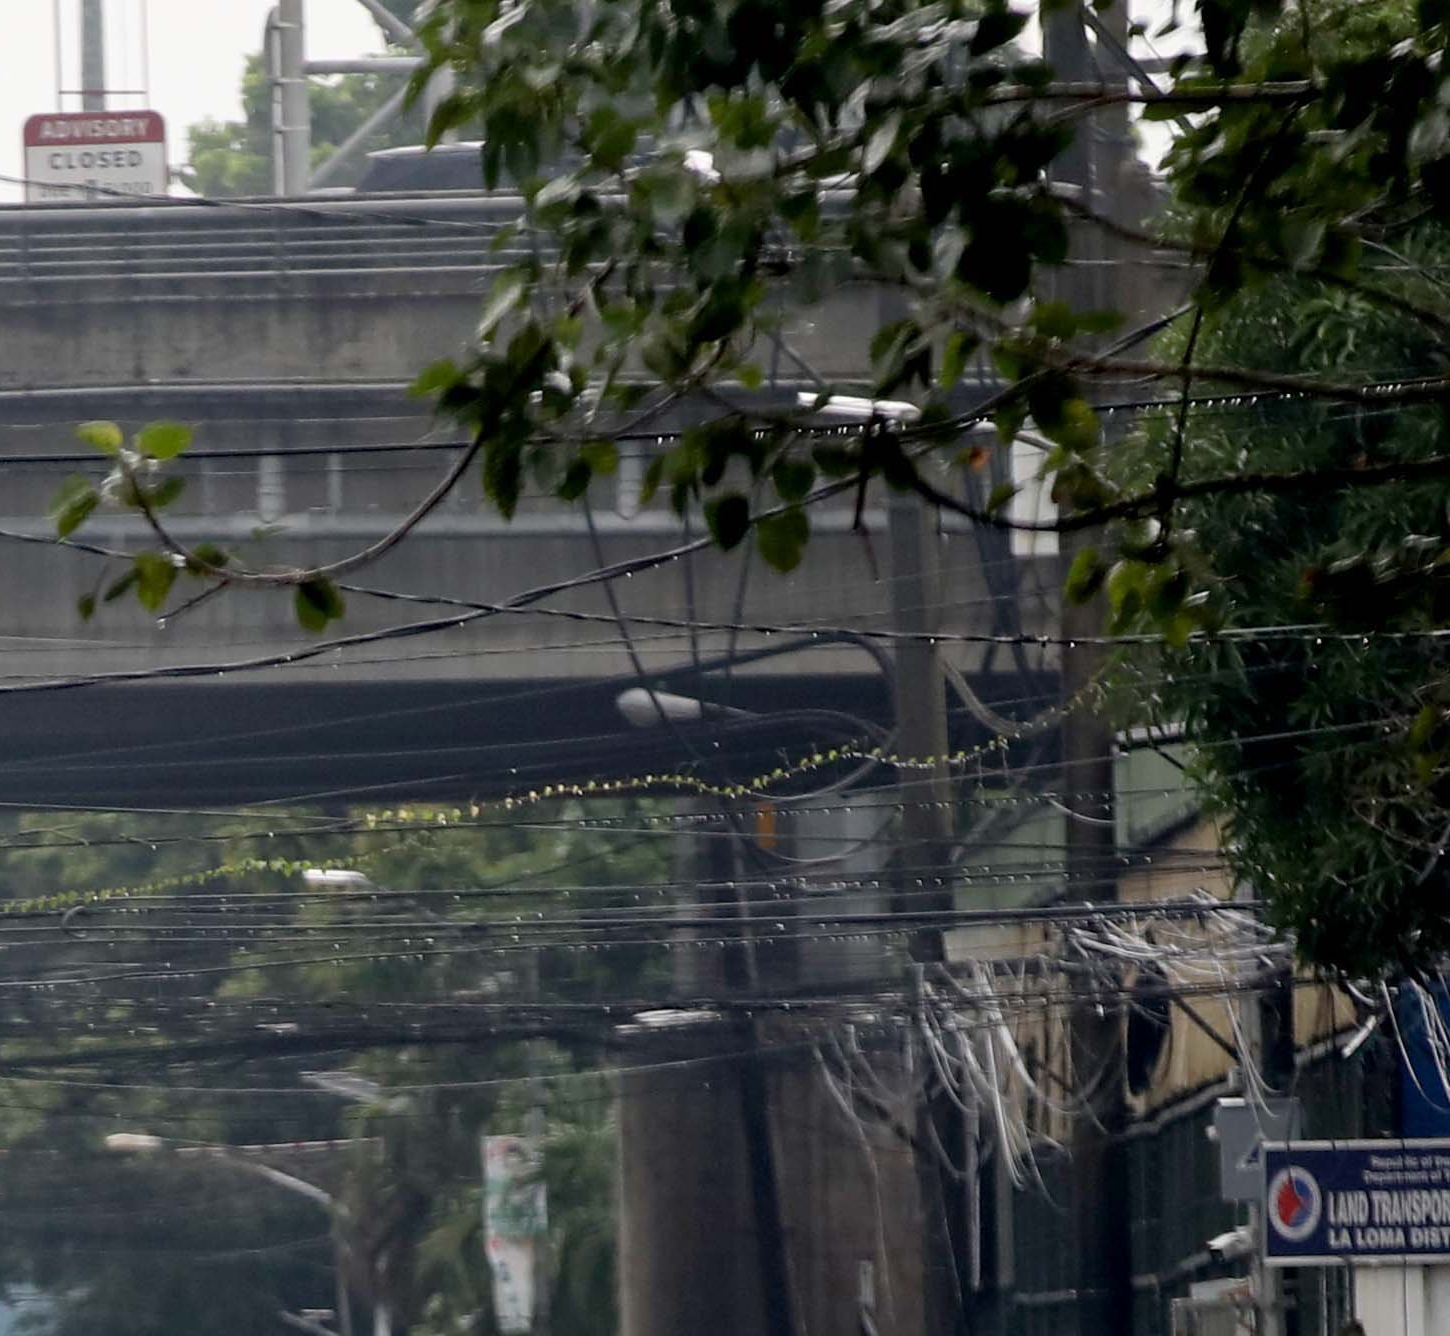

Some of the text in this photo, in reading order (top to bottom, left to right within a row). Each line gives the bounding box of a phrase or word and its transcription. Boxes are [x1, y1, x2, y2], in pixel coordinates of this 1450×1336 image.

[40, 119, 151, 139] ADVISORY
[49, 149, 143, 169] CLOSED
[1328, 1190, 1369, 1227] LAND
[1328, 1228, 1352, 1249] LA
[1356, 1227, 1406, 1248] LOMA
